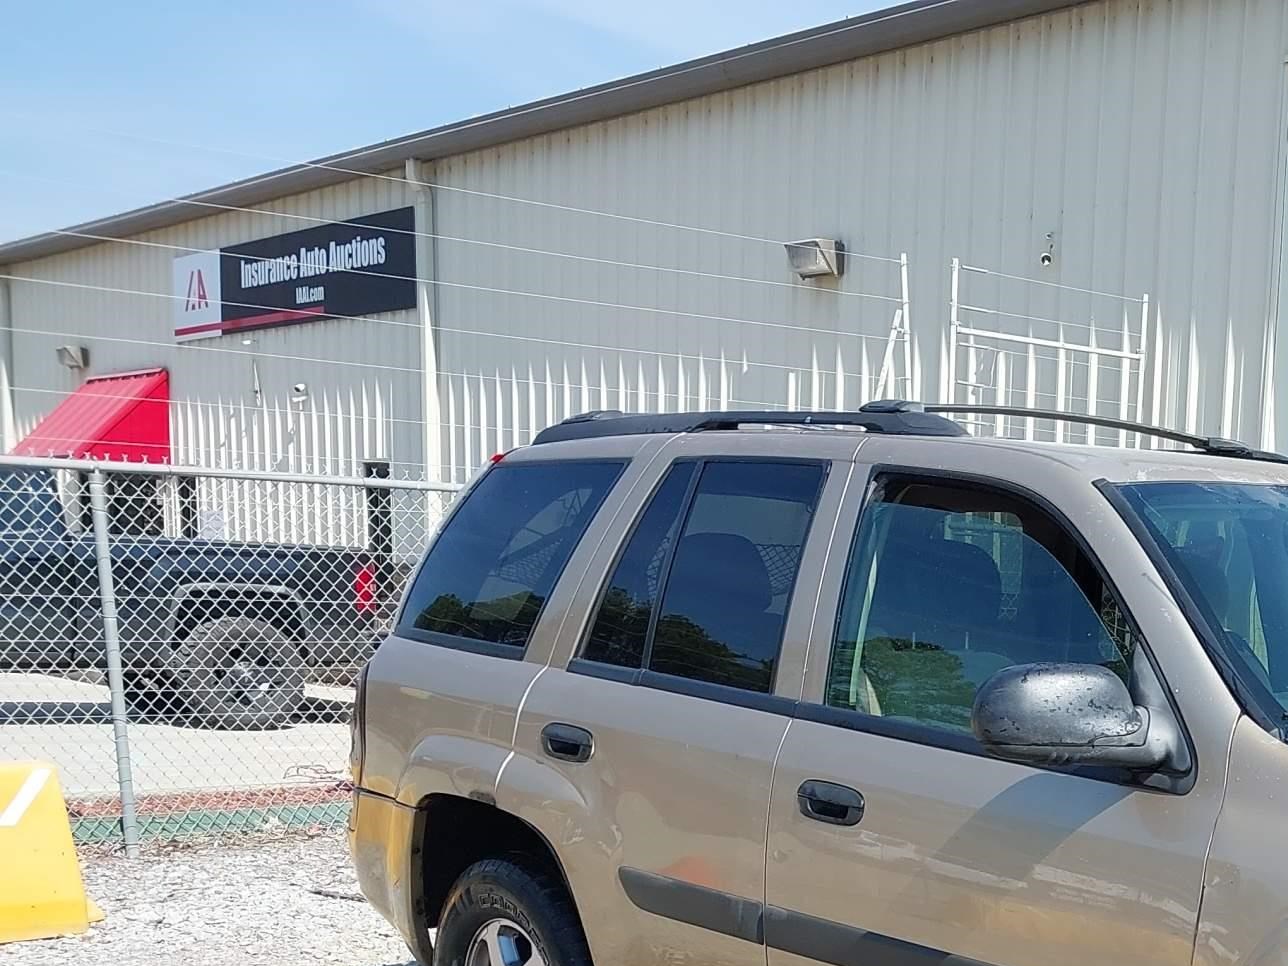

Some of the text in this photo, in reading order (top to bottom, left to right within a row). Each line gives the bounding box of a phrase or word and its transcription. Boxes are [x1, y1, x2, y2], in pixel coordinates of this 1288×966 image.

[240, 235, 386, 289] Insurance Auto Auctions
